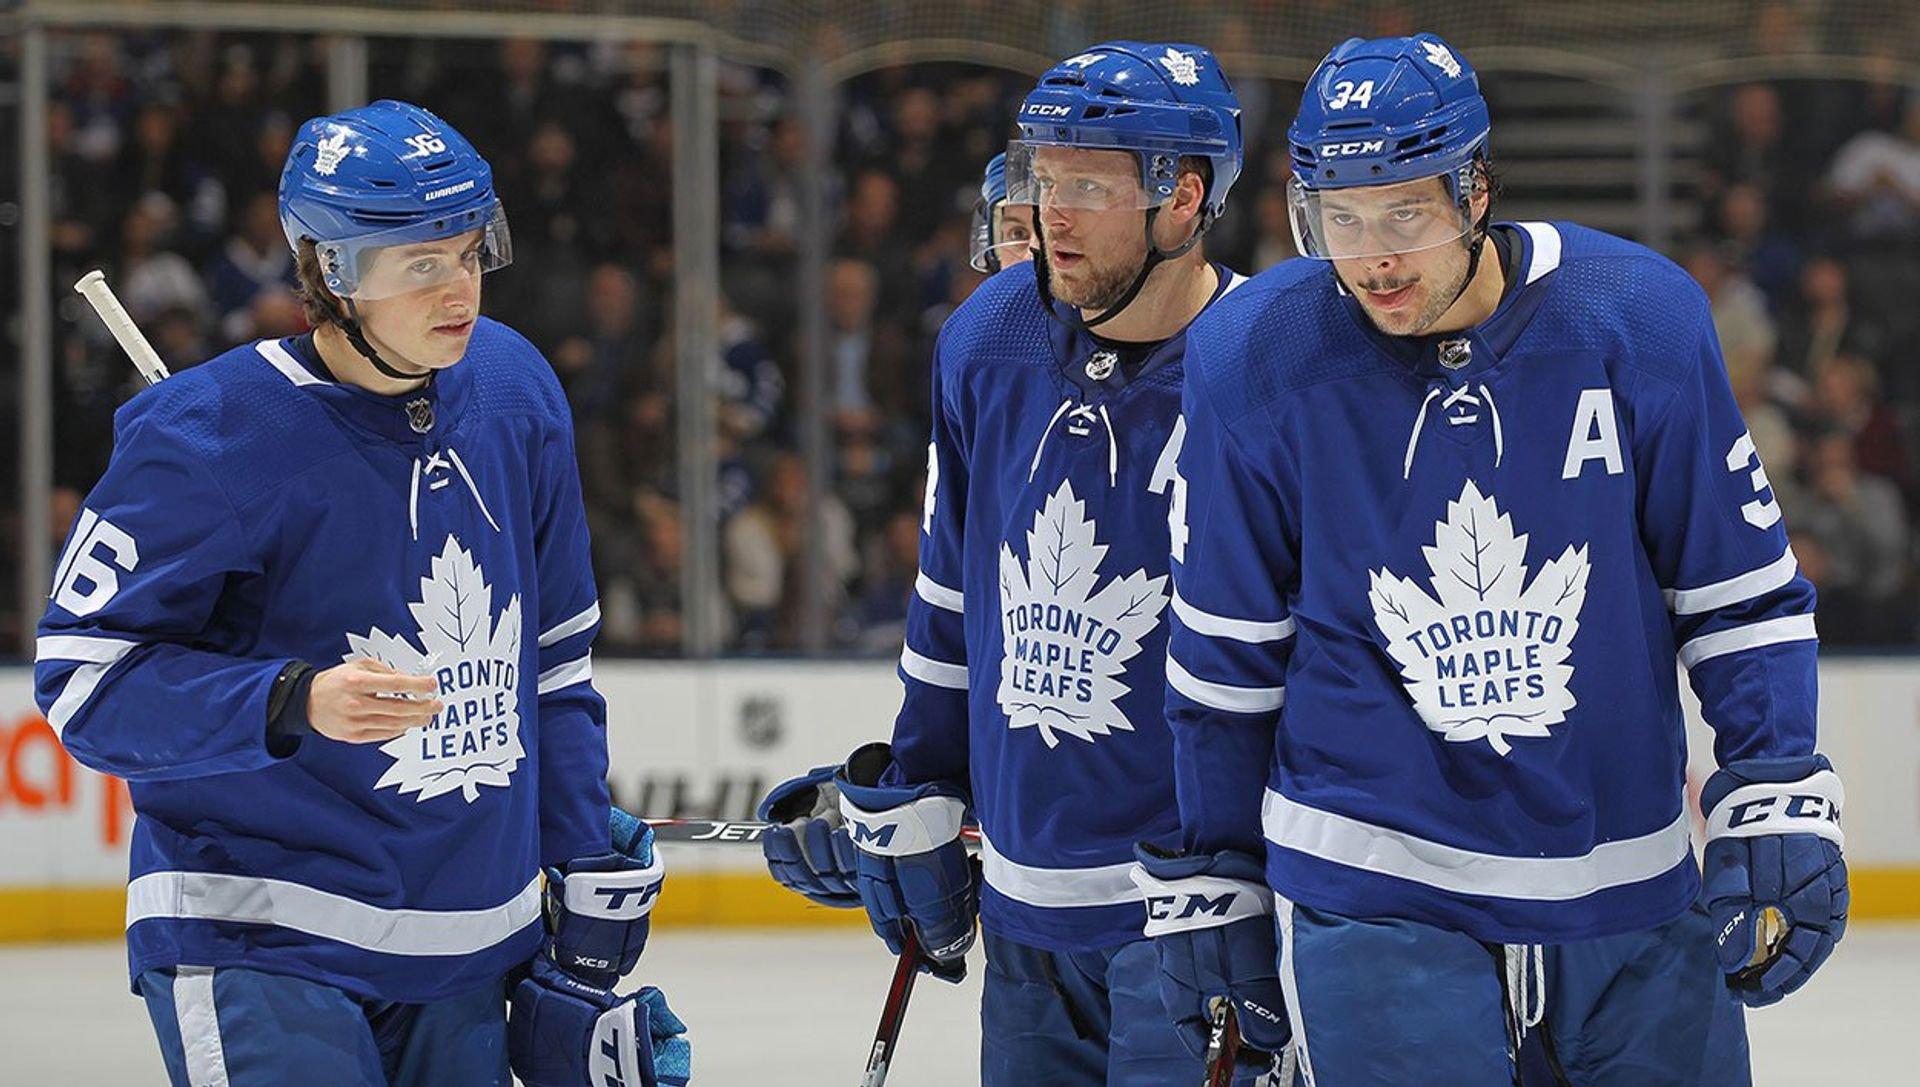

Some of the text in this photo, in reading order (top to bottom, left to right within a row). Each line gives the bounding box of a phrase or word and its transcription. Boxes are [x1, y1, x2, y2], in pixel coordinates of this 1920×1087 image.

[1027, 103, 1072, 117] CCM
[1328, 79, 1375, 110] 34
[1320, 139, 1386, 157] CCM
[425, 179, 475, 201] WARRIOR
[1561, 388, 1625, 480] A
[48, 506, 140, 618] 16
[1006, 602, 1122, 656] TORONTO
[1405, 608, 1564, 659] TORONTO
[1014, 635, 1095, 674] MAPLE
[1435, 643, 1543, 680] MAPLE
[436, 658, 515, 696] RONTO
[1011, 664, 1093, 703] LEAFS
[1438, 673, 1546, 708] LEAFS
[421, 721, 509, 760] LEAFS
[1717, 911, 1746, 947] CCM
[1243, 999, 1281, 1024] CCM
